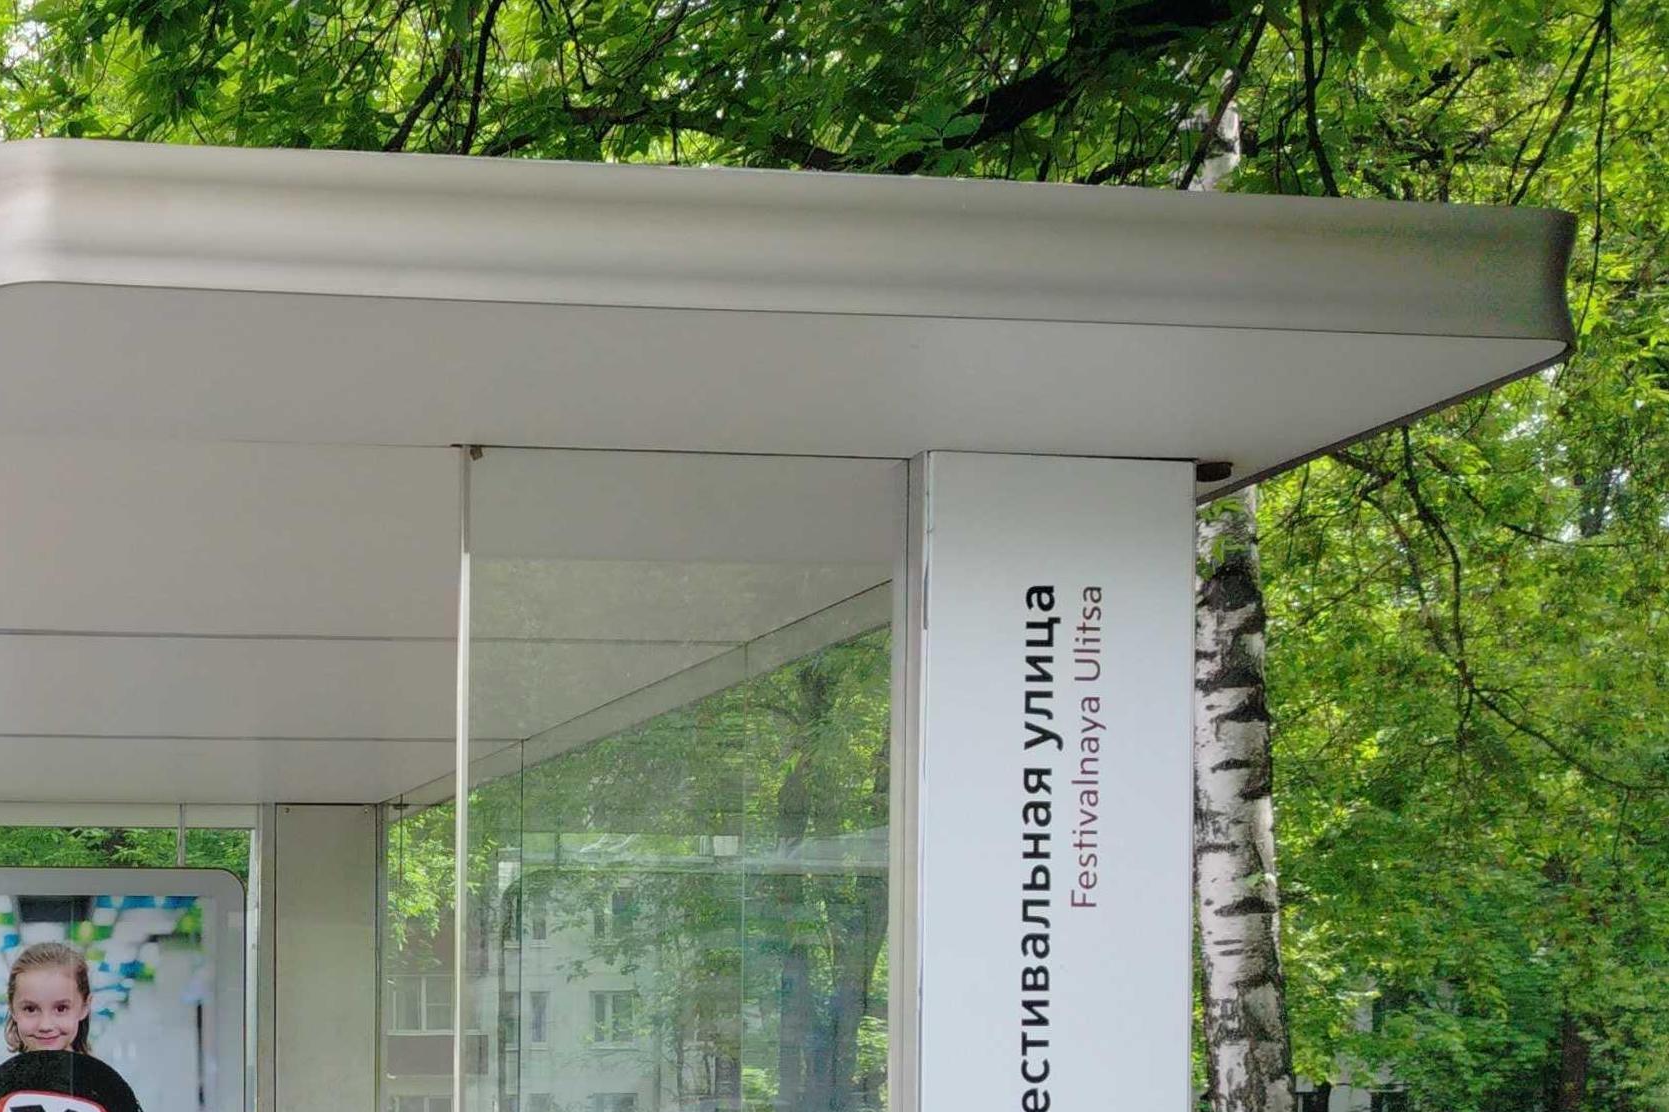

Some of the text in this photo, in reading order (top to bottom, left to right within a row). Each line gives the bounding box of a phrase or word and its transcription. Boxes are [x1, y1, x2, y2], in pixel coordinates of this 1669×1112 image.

[1023, 585, 1063, 752] улица
[1070, 586, 1107, 908] Festivalnaya Ulitsa
